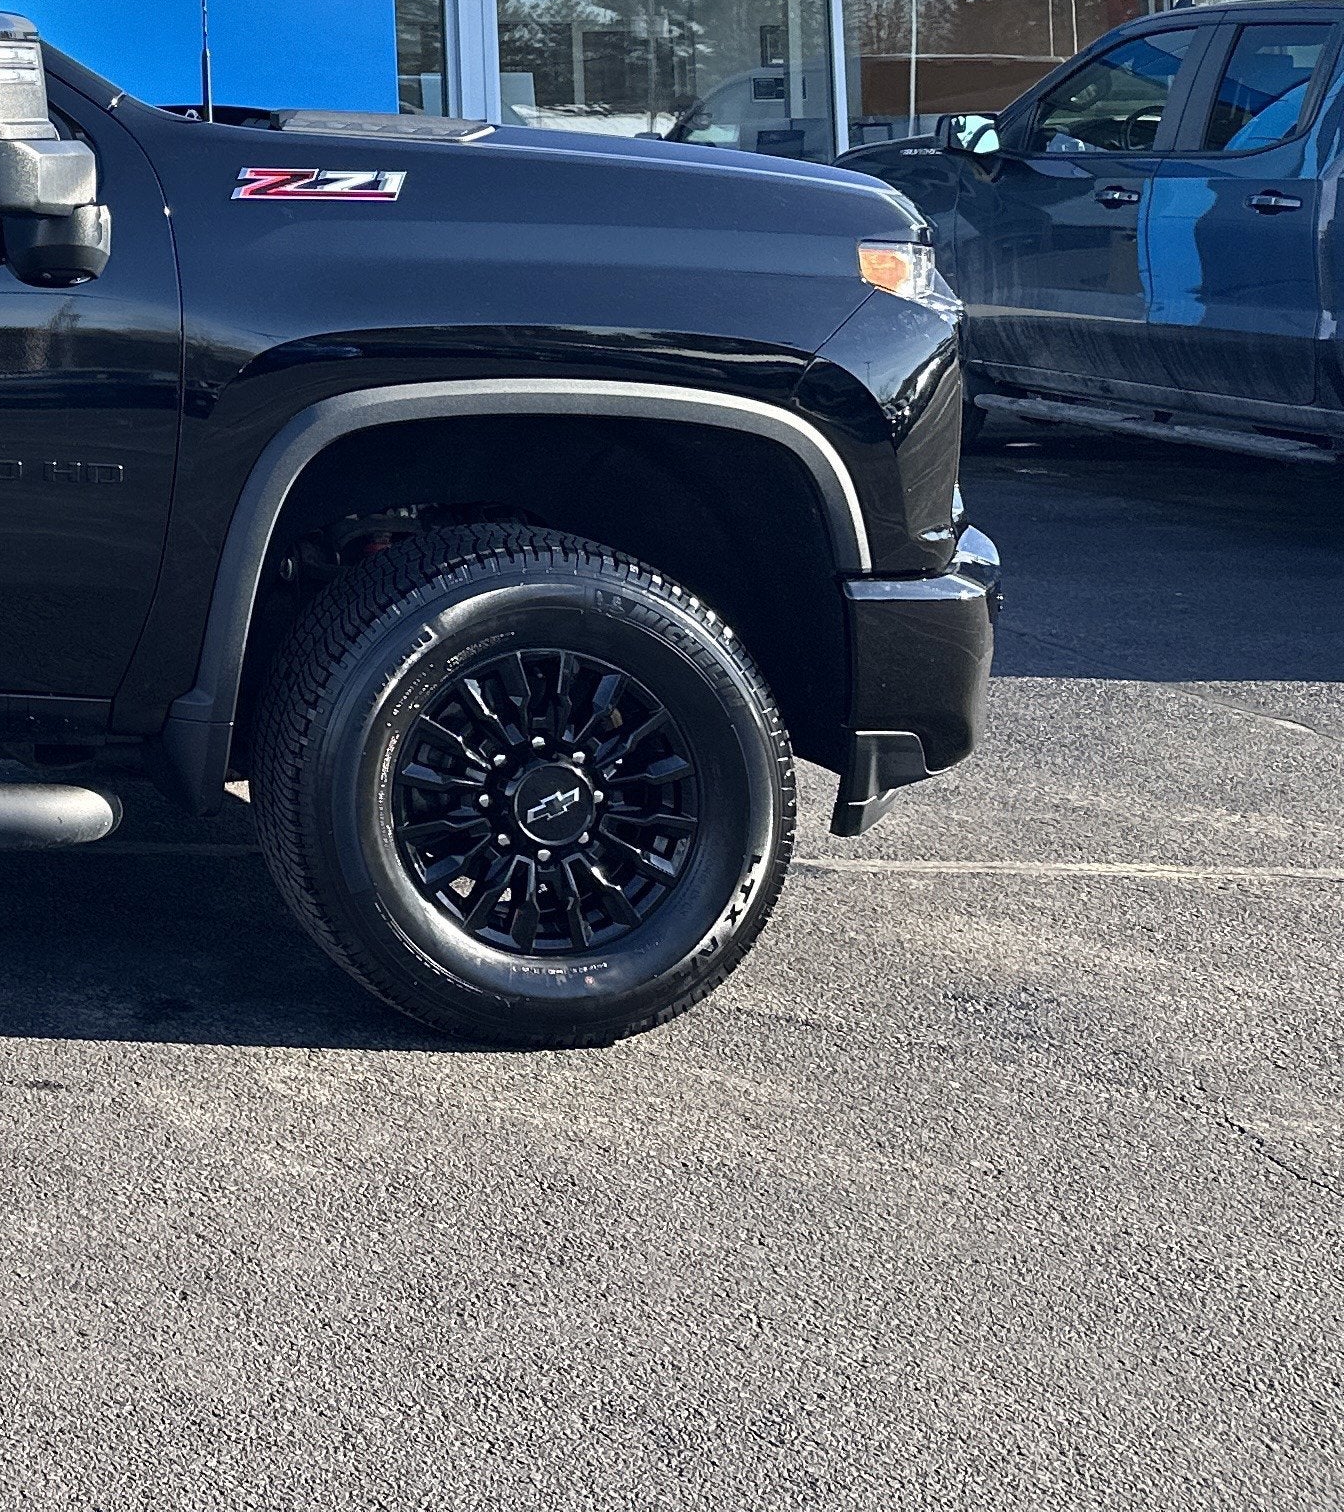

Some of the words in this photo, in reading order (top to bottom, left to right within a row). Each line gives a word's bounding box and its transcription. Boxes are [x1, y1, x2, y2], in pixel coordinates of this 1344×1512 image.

[231, 166, 407, 201] Z71
[41, 460, 124, 484] HD
[629, 603, 746, 707] MICHELIN
[723, 854, 763, 927] LTX
